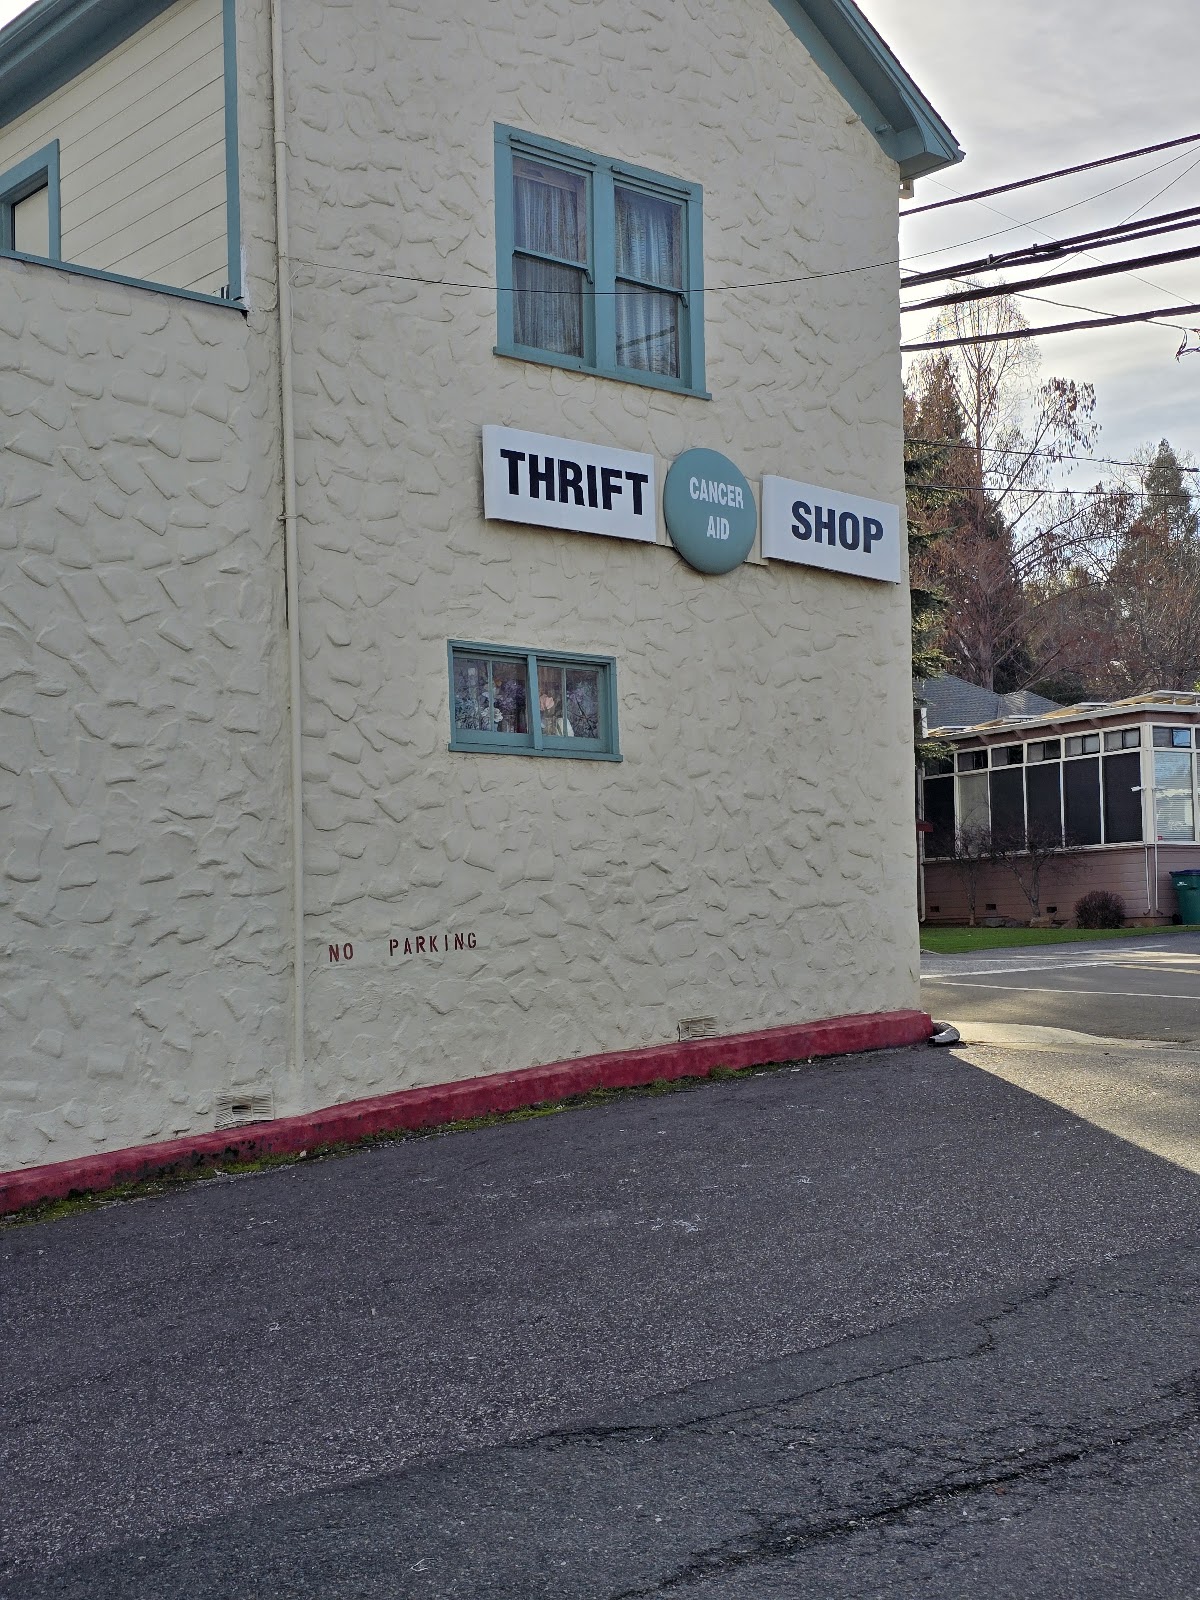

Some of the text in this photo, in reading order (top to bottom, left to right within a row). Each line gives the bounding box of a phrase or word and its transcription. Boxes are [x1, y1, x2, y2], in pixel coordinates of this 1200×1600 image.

[500, 448, 649, 516] THRIFT
[689, 476, 744, 509] CANCER
[706, 516, 730, 541] AID
[791, 500, 884, 554] SHOP
[328, 932, 477, 963] NO PARKING
